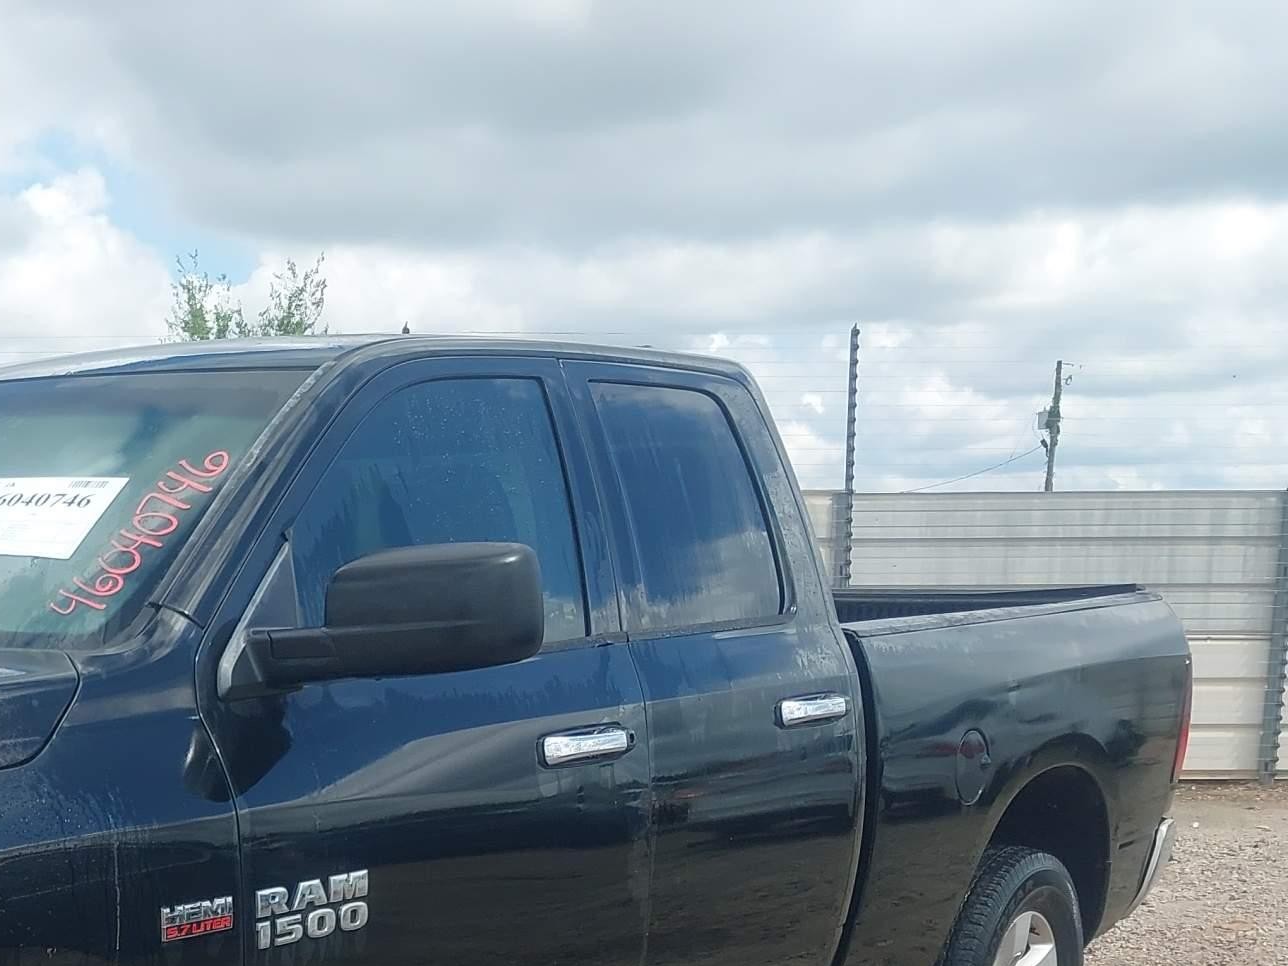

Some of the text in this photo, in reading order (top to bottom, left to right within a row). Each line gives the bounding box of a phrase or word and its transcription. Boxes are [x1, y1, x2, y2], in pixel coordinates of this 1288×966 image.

[50, 450, 230, 615] 46040746
[161, 896, 233, 925] HEMI
[256, 870, 369, 918] RAM
[166, 917, 231, 938] 5.7 LITER
[256, 902, 369, 950] 1500
